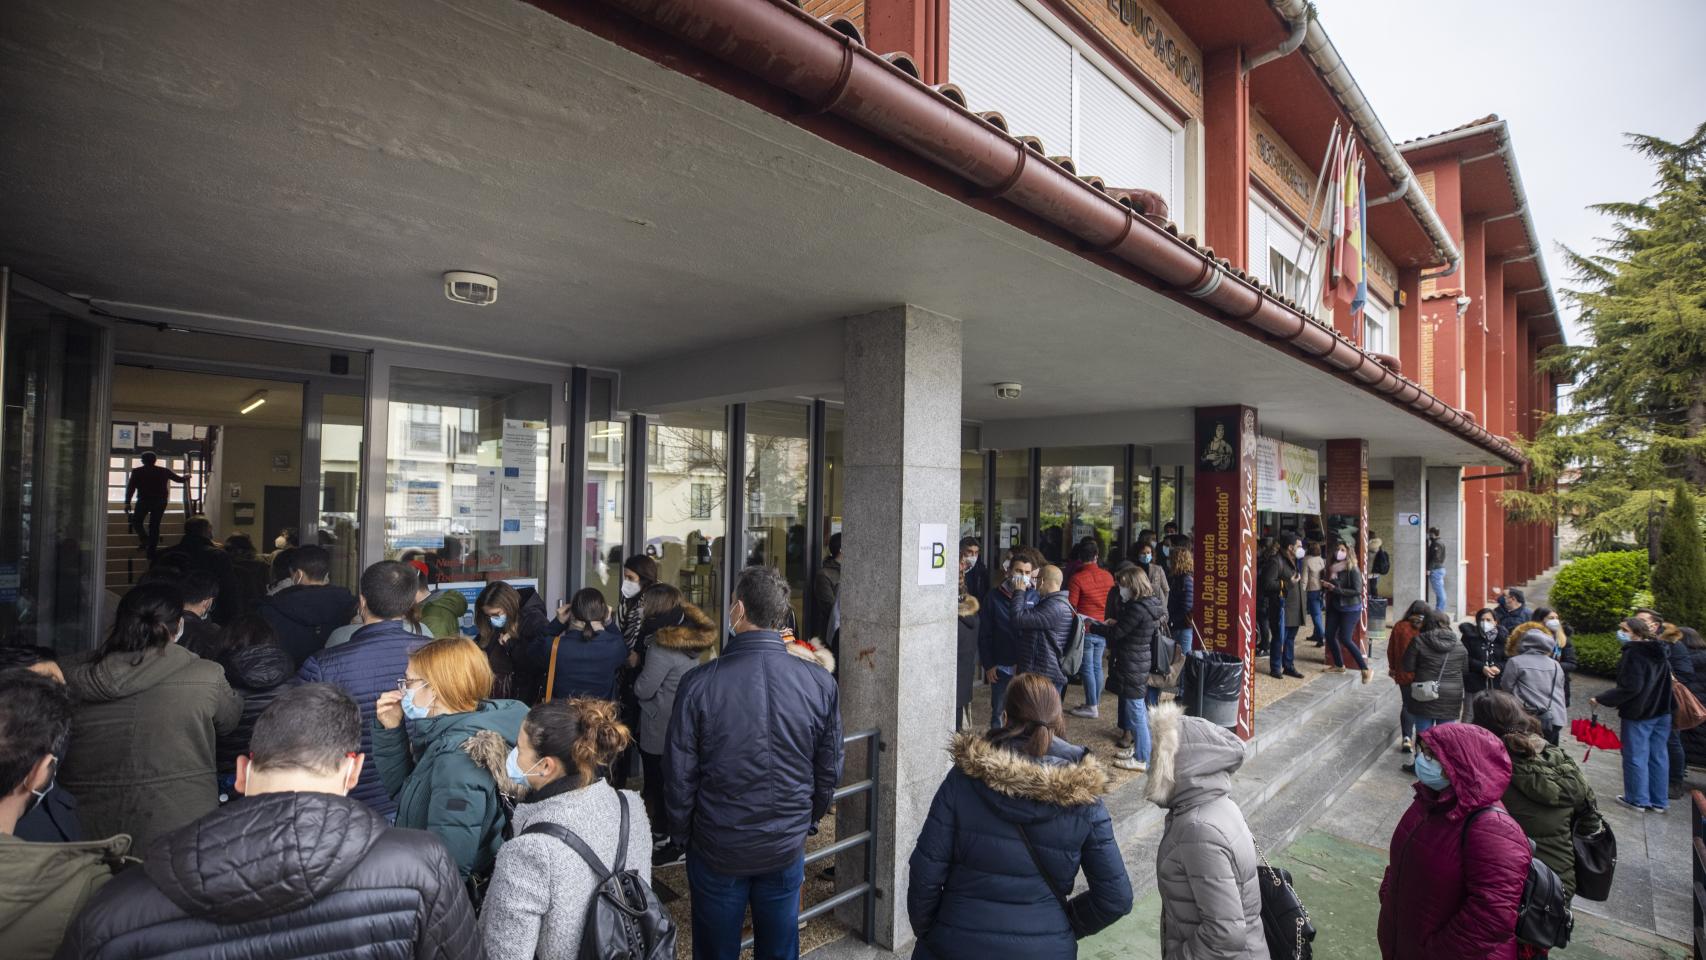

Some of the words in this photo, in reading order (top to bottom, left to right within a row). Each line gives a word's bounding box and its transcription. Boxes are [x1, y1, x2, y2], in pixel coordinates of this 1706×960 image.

[1241, 464, 1253, 543] Vinci
[1009, 526, 1019, 546] B
[932, 542, 945, 569] B
[1203, 534, 1215, 572] cuenta
[1215, 554, 1229, 578] está
[1241, 544, 1253, 599] Da
[1202, 575, 1215, 601] Date
[1215, 581, 1228, 606] todo
[1203, 605, 1214, 624] ver.
[1216, 609, 1230, 630] que
[1204, 627, 1214, 635] a
[1215, 633, 1228, 648] de
[1239, 604, 1252, 737] Leonardo
